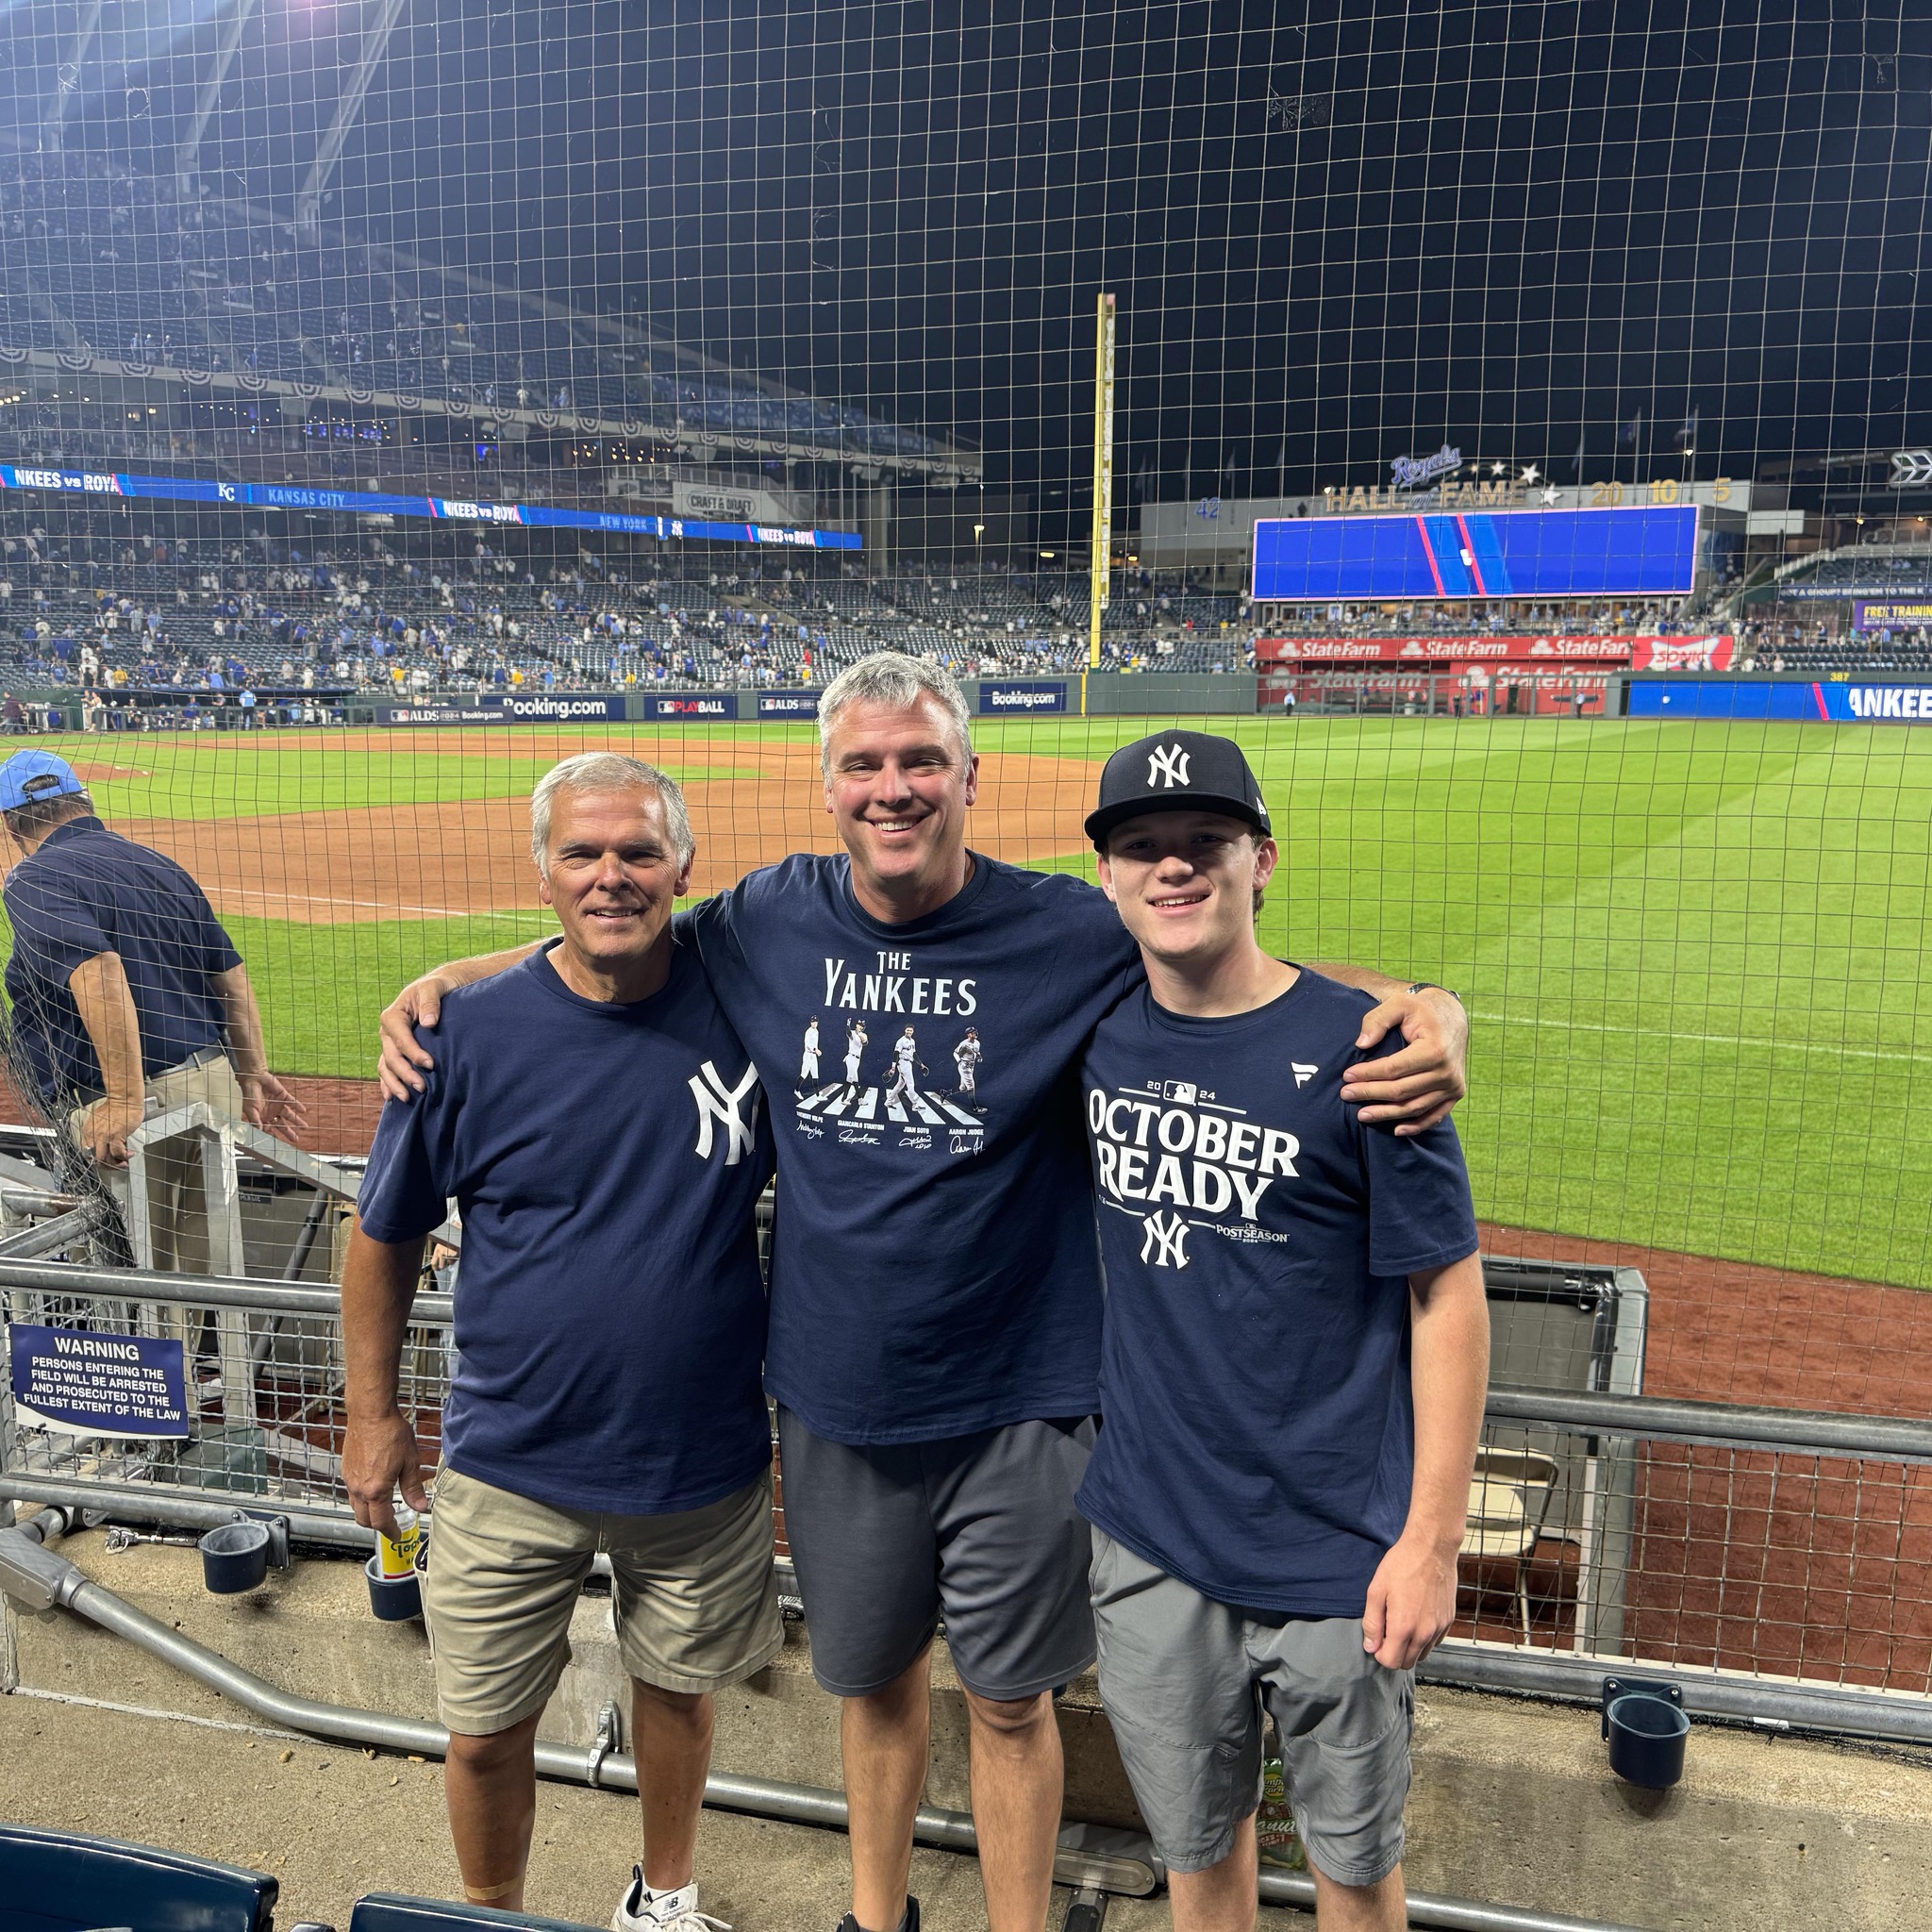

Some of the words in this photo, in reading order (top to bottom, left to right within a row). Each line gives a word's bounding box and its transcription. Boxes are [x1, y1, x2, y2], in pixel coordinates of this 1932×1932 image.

[14, 469, 62, 488] NKEES
[63, 476, 82, 488] vs
[1712, 476, 1732, 503] 5
[268, 489, 316, 506] KANSAS
[319, 492, 345, 508] CITY
[691, 495, 716, 510] CRAFT
[1326, 484, 1406, 512] HALL
[1440, 479, 1527, 508] FAME
[1591, 480, 1623, 507] 20
[1648, 478, 1677, 504] 10
[774, 699, 799, 710] ALDS
[991, 691, 1056, 708] Booking.com
[1848, 688, 1932, 718] ANKEE
[409, 710, 439, 722] ALDS
[461, 710, 504, 721] Booking.com
[1146, 742, 1191, 789] NY
[876, 951, 912, 974] THE
[824, 958, 977, 1016] YANKEES
[1146, 1080, 1161, 1091] 20
[1199, 1090, 1216, 1101] 24
[687, 1059, 762, 1166] NY
[1089, 1089, 1300, 1177] OCTOBER
[1096, 1139, 1274, 1221] READY
[1140, 1209, 1191, 1270] NY
[1216, 1224, 1289, 1243] POSTSEASON
[55, 1337, 140, 1361] WARNING
[32, 1357, 83, 1372] PERSONS
[85, 1361, 141, 1377] ENTERING
[142, 1368, 164, 1380] THE
[31, 1369, 61, 1382] FIELD
[64, 1374, 90, 1385] WILL
[92, 1375, 107, 1387] BE
[108, 1378, 167, 1393] ARRESTED
[31, 1382, 54, 1394] AND
[56, 1385, 128, 1403] PROSECUTED
[130, 1393, 145, 1405] TO
[148, 1395, 170, 1407] THE
[24, 1393, 69, 1408] FULLEST
[71, 1400, 112, 1414] EXTENT
[114, 1405, 130, 1416] OF
[131, 1407, 154, 1419] THE
[156, 1409, 180, 1422] LAW
[390, 1536, 421, 1558] Top
